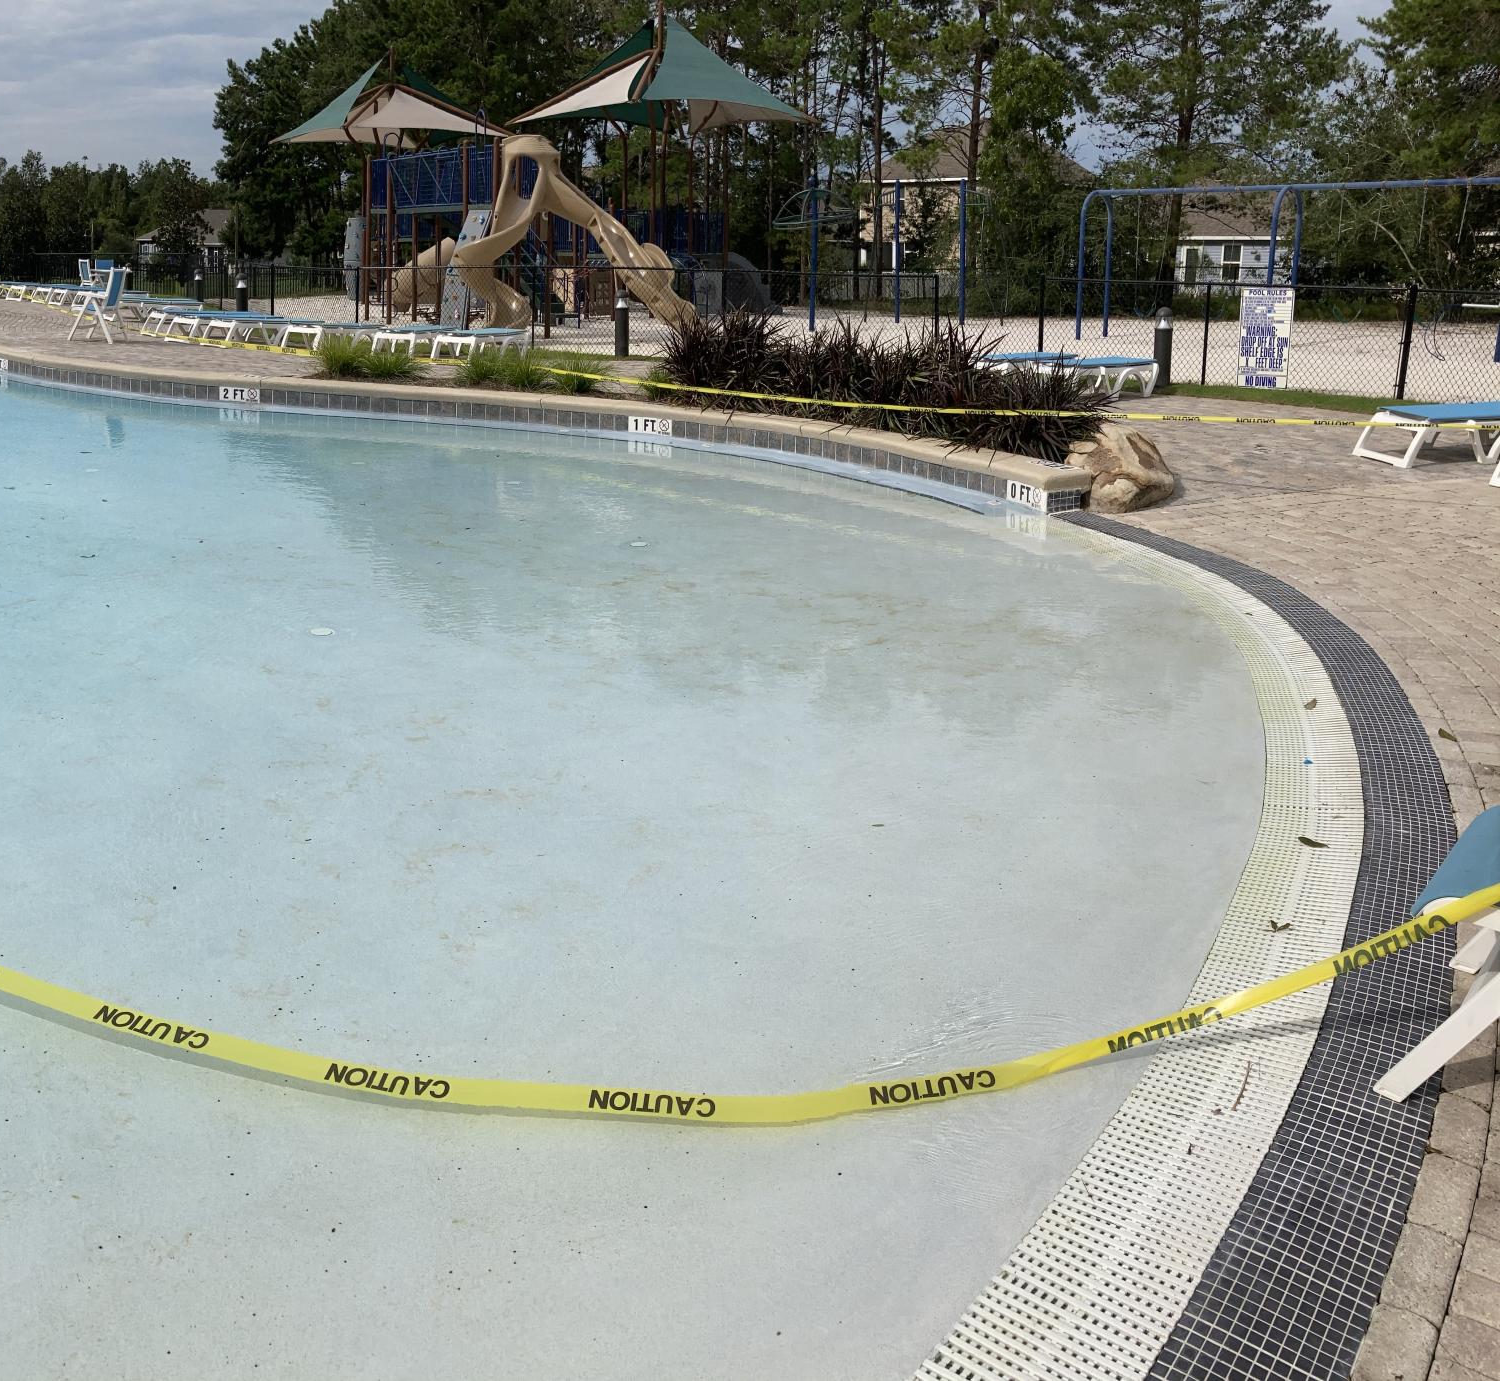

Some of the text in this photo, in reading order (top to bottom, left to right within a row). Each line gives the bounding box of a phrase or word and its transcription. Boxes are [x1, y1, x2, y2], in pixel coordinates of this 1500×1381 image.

[1241, 336, 1289, 348] DROP OFF AT SUN
[1240, 347, 1284, 358] SHELF EDGE IS
[1255, 358, 1268, 369] FEET
[1245, 375, 1277, 388] NO DIVING
[223, 388, 229, 399] 2
[634, 419, 638, 431] 1
[1011, 483, 1016, 498] 0
[93, 1004, 210, 1049] CAUTION
[324, 1062, 451, 1100] CAUTION
[868, 1069, 997, 1106] CAUTION
[588, 1088, 717, 1118] CAUTION
